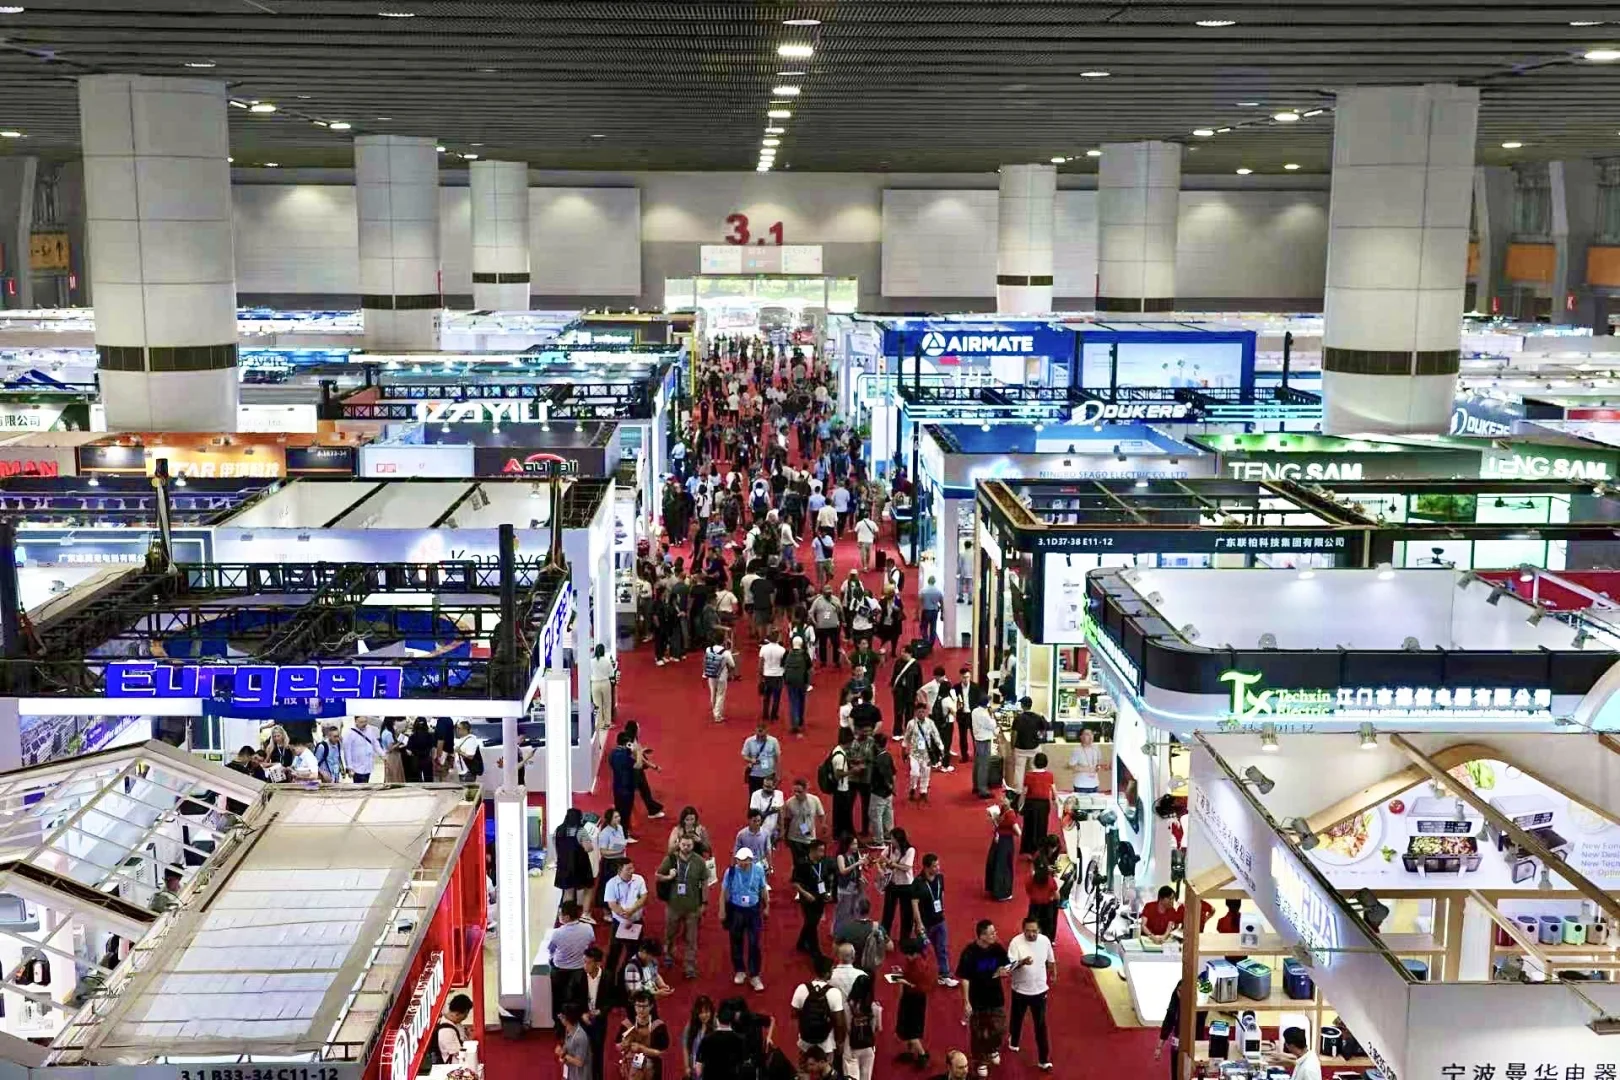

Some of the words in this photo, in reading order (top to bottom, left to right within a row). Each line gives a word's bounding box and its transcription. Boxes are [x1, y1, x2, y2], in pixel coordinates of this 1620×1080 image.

[725, 213, 784, 246] 3.1
[947, 336, 1034, 352] AIRMATE
[1104, 404, 1187, 418] DUKERS
[0, 415, 40, 427] 限公司
[1039, 471, 1076, 479] NINGBO
[1079, 471, 1108, 479] SEAGO
[1111, 471, 1150, 479] ELECTRIC
[1228, 462, 1301, 479] TENG
[1083, 538, 1113, 546] E11-12
[1276, 688, 1331, 703] Techxin
[1275, 704, 1330, 716] Electric
